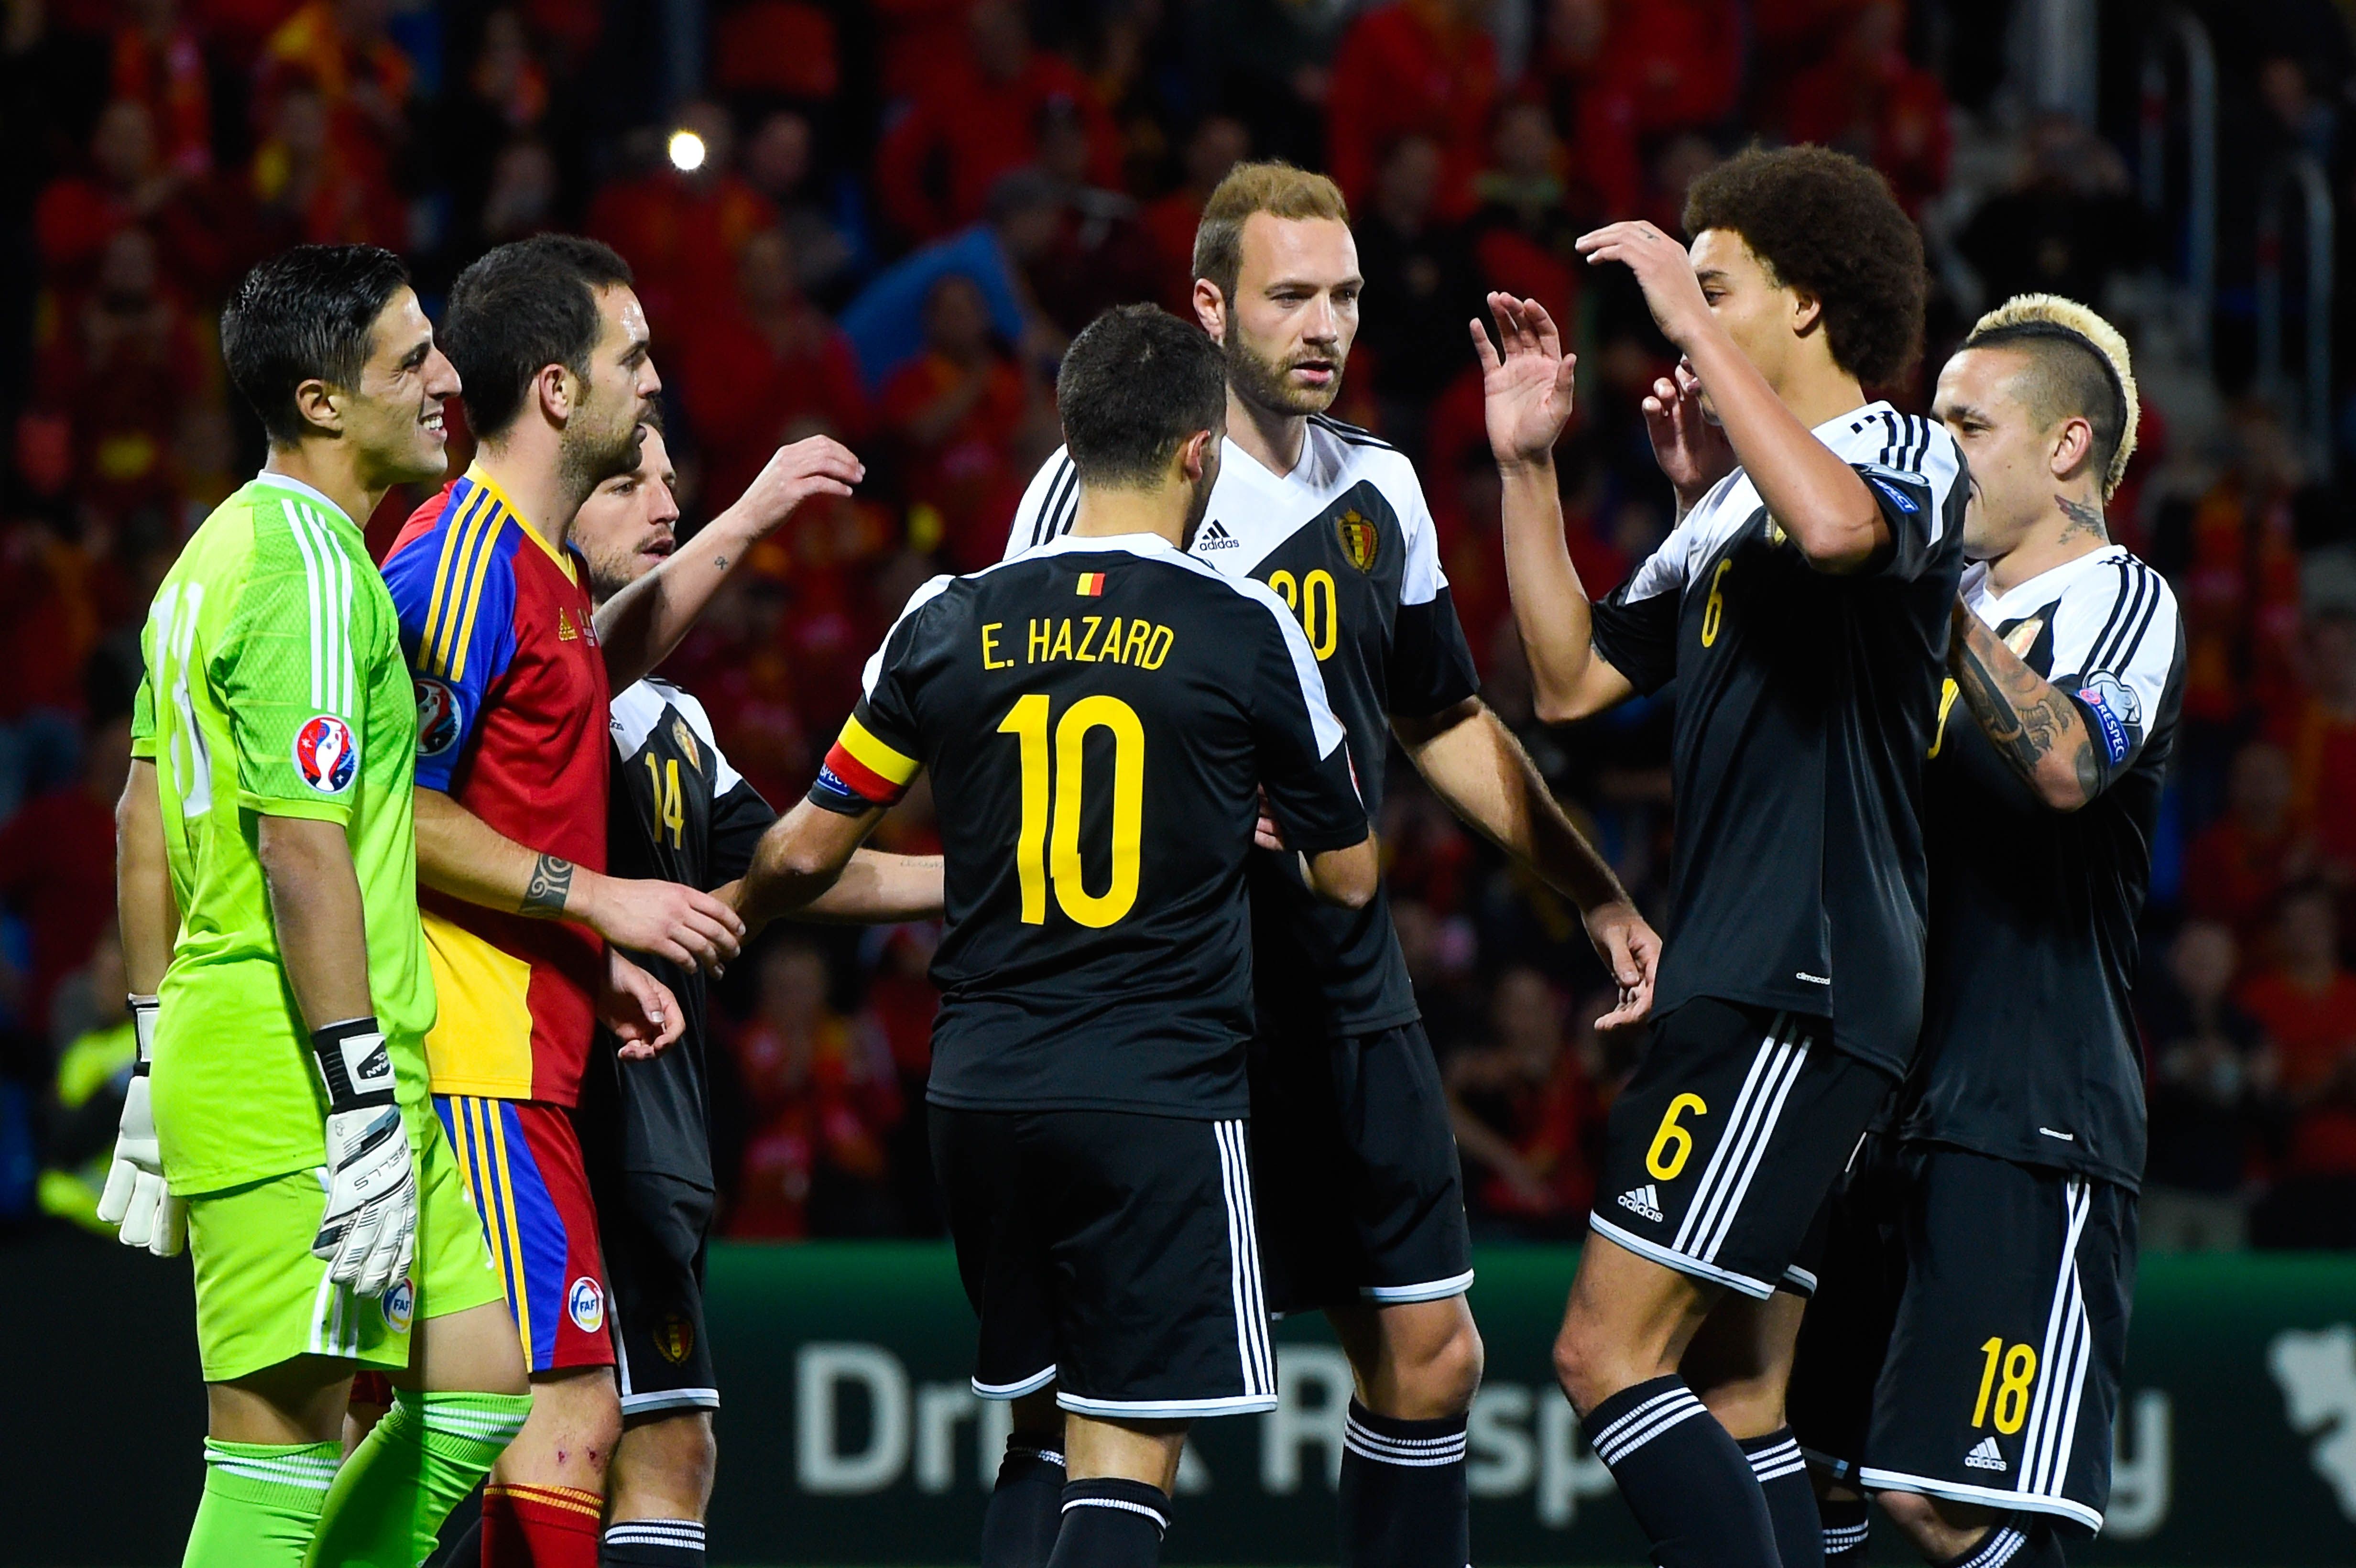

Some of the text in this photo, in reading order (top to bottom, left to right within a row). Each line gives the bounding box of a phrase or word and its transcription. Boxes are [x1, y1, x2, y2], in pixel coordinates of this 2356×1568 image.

[1872, 478, 1915, 511] SPECT
[1200, 539, 1239, 551] adidas
[1702, 558, 1732, 648] 6
[982, 616, 1175, 670] E. HAZARD
[819, 762, 848, 788] SPEC
[645, 752, 684, 850] 14
[997, 694, 1145, 928] 10
[366, 1059, 389, 1078] RAN
[1646, 1093, 1707, 1181] 6
[1617, 1195, 1664, 1222] adidas
[393, 1298, 409, 1311] FAF
[580, 1298, 595, 1311] FAF
[1971, 1337, 2037, 1435] 18
[1964, 1457, 2007, 1471] adidas
